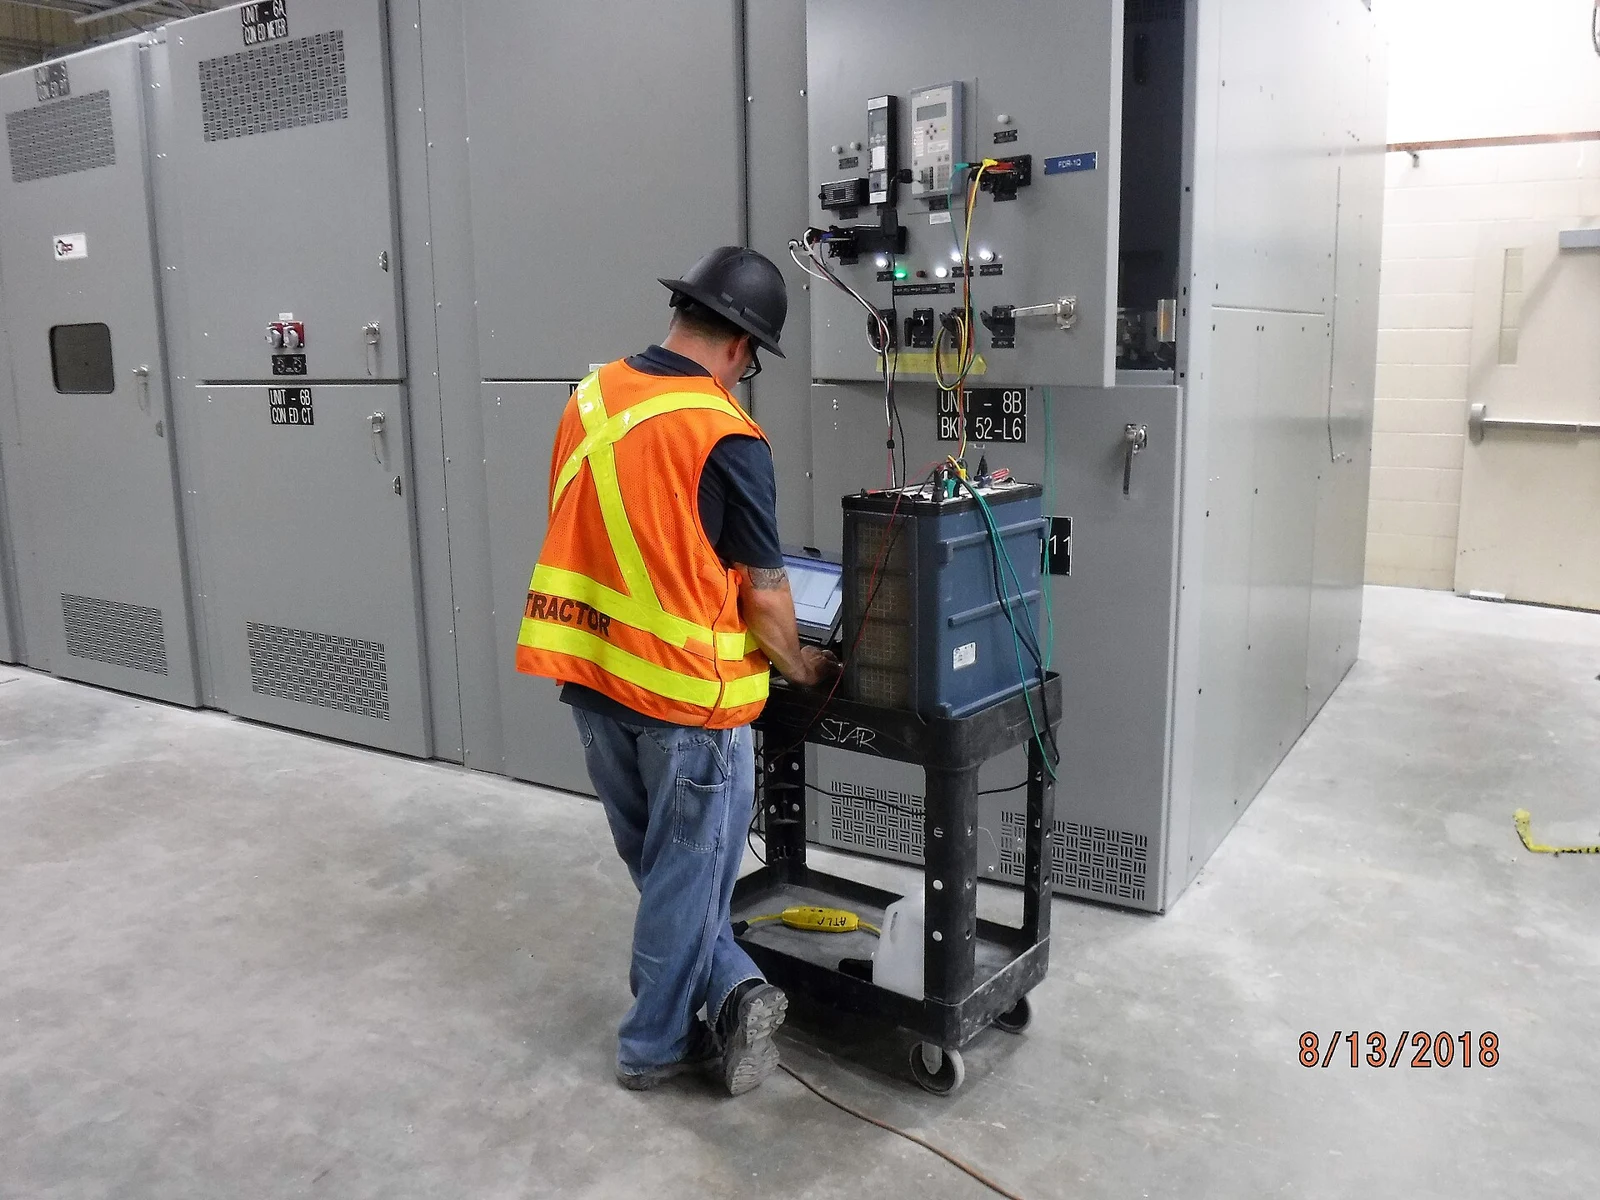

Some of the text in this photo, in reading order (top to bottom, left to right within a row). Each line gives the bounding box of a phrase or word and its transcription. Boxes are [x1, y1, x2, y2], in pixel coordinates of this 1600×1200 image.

[270, 389, 286, 405] UNIT
[300, 389, 311, 406] 6B
[941, 390, 972, 413] UNT
[1002, 390, 1022, 414] 8B
[272, 407, 311, 424] CON ED CT
[975, 417, 1022, 440] 52-L6
[820, 718, 884, 756] STAR
